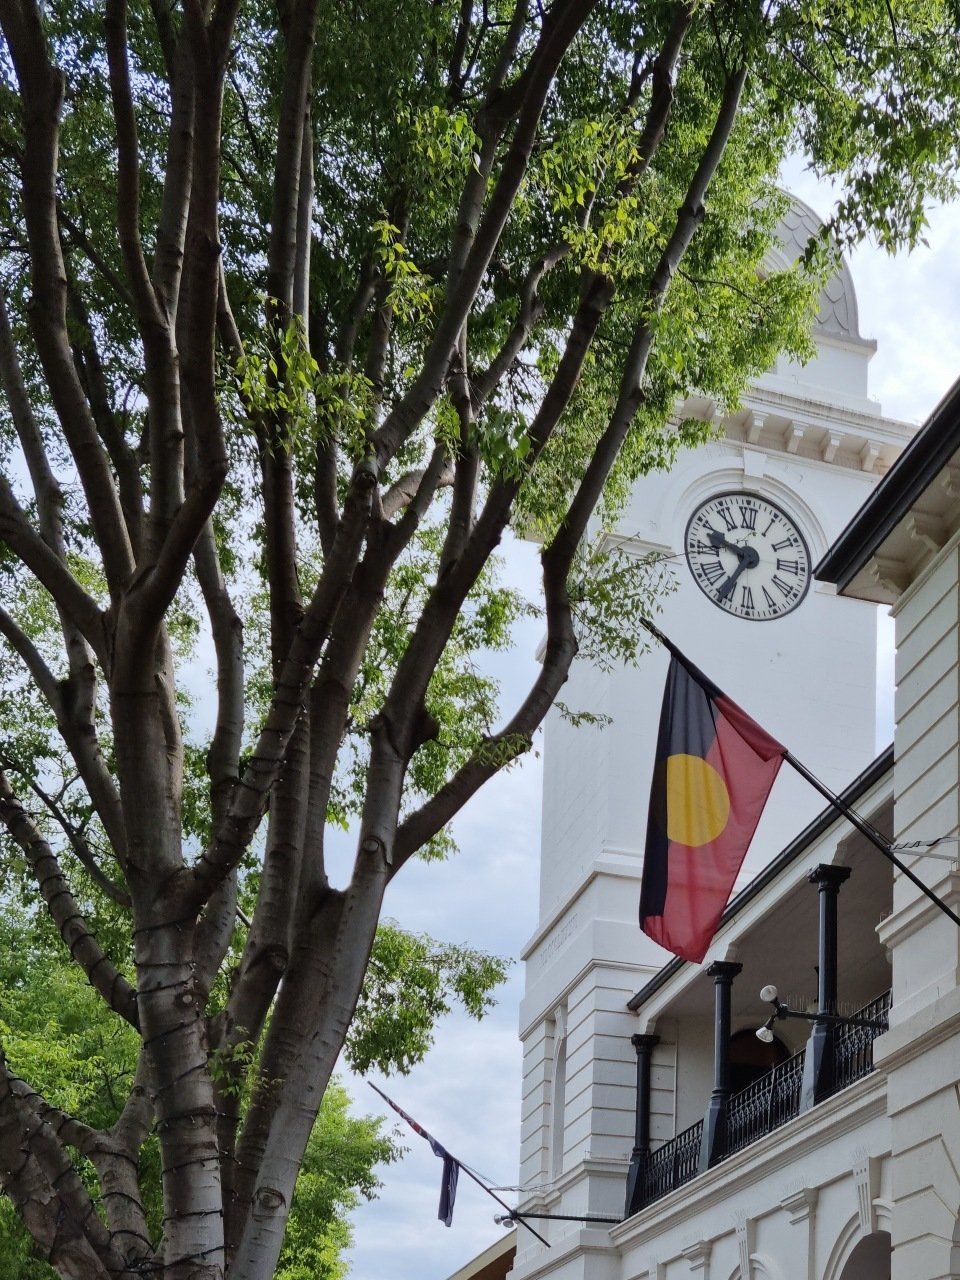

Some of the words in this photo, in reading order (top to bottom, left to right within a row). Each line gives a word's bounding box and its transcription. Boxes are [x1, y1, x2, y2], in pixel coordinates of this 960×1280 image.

[717, 507, 738, 532] XI
[739, 506, 758, 531] XII
[771, 537, 794, 552] II
[777, 559, 798, 576] III
